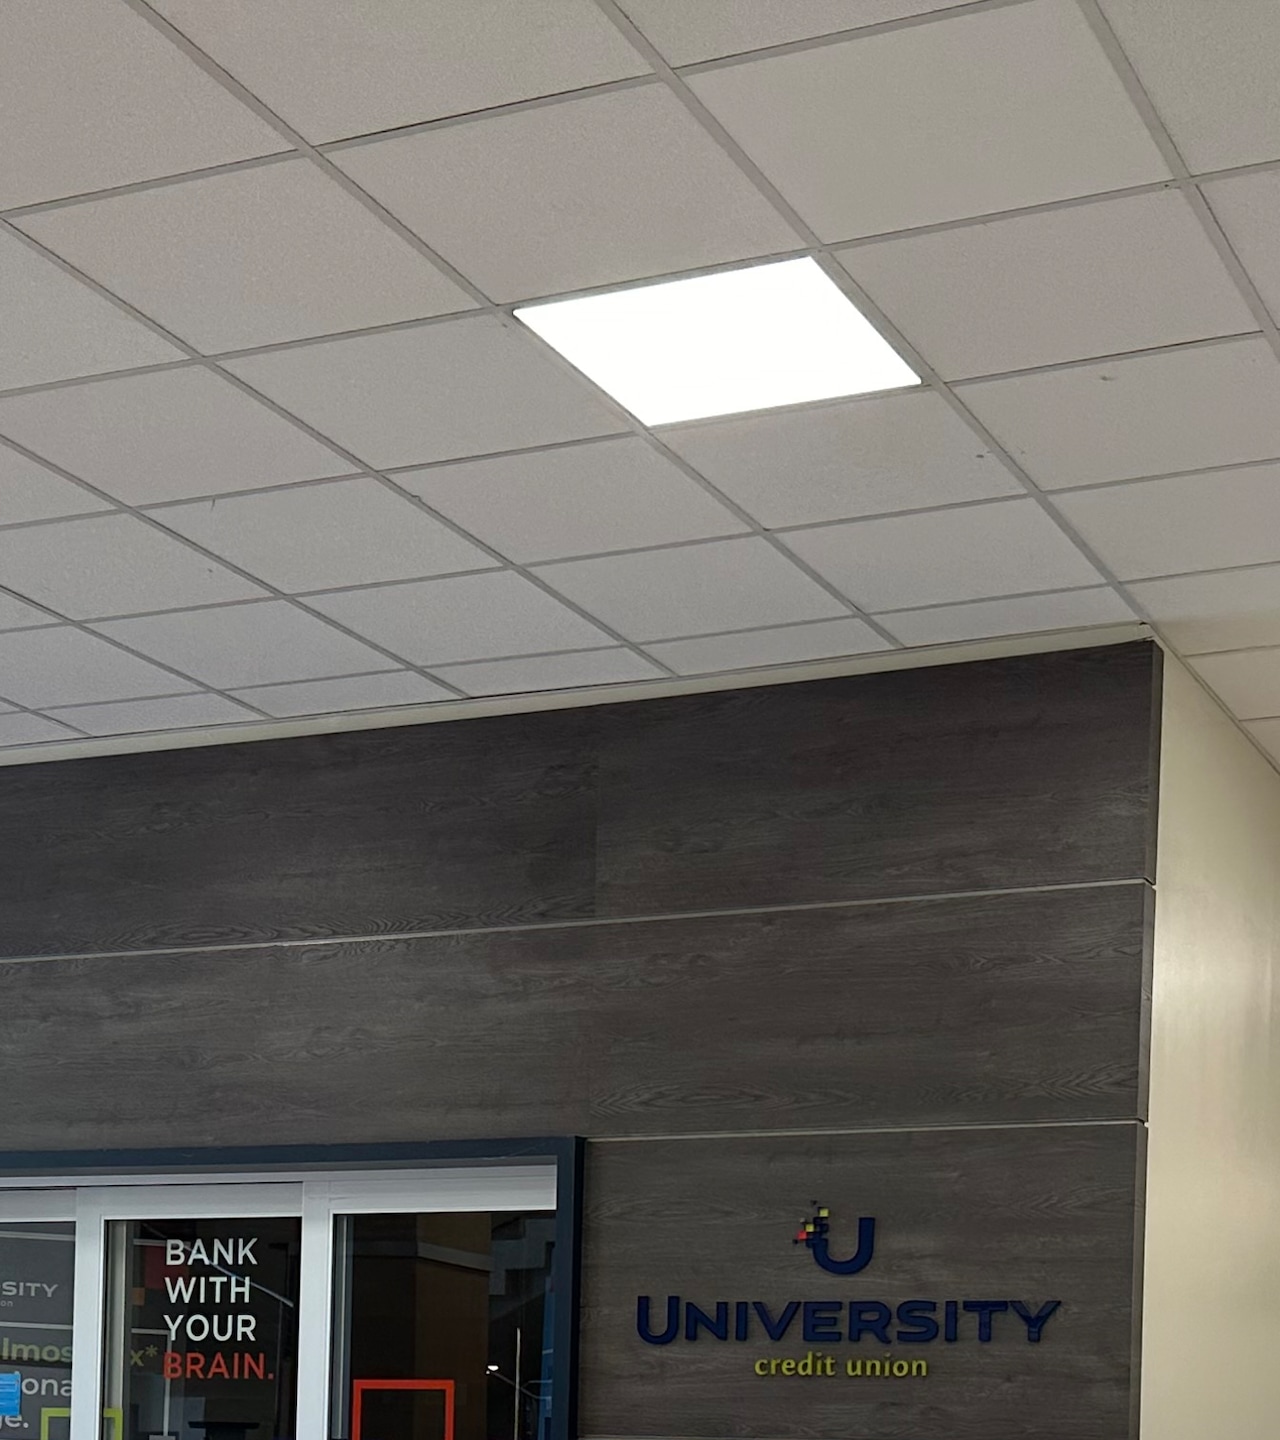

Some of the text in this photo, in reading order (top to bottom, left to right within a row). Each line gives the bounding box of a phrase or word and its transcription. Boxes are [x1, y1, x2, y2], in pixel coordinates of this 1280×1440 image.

[165, 1238, 259, 1266] BANK
[164, 1276, 251, 1304] WITH
[163, 1313, 257, 1342] YOUR
[636, 1295, 1062, 1345] UNIVERSITY
[163, 1352, 275, 1380] BRAIN.
[754, 1352, 929, 1378] credit union
